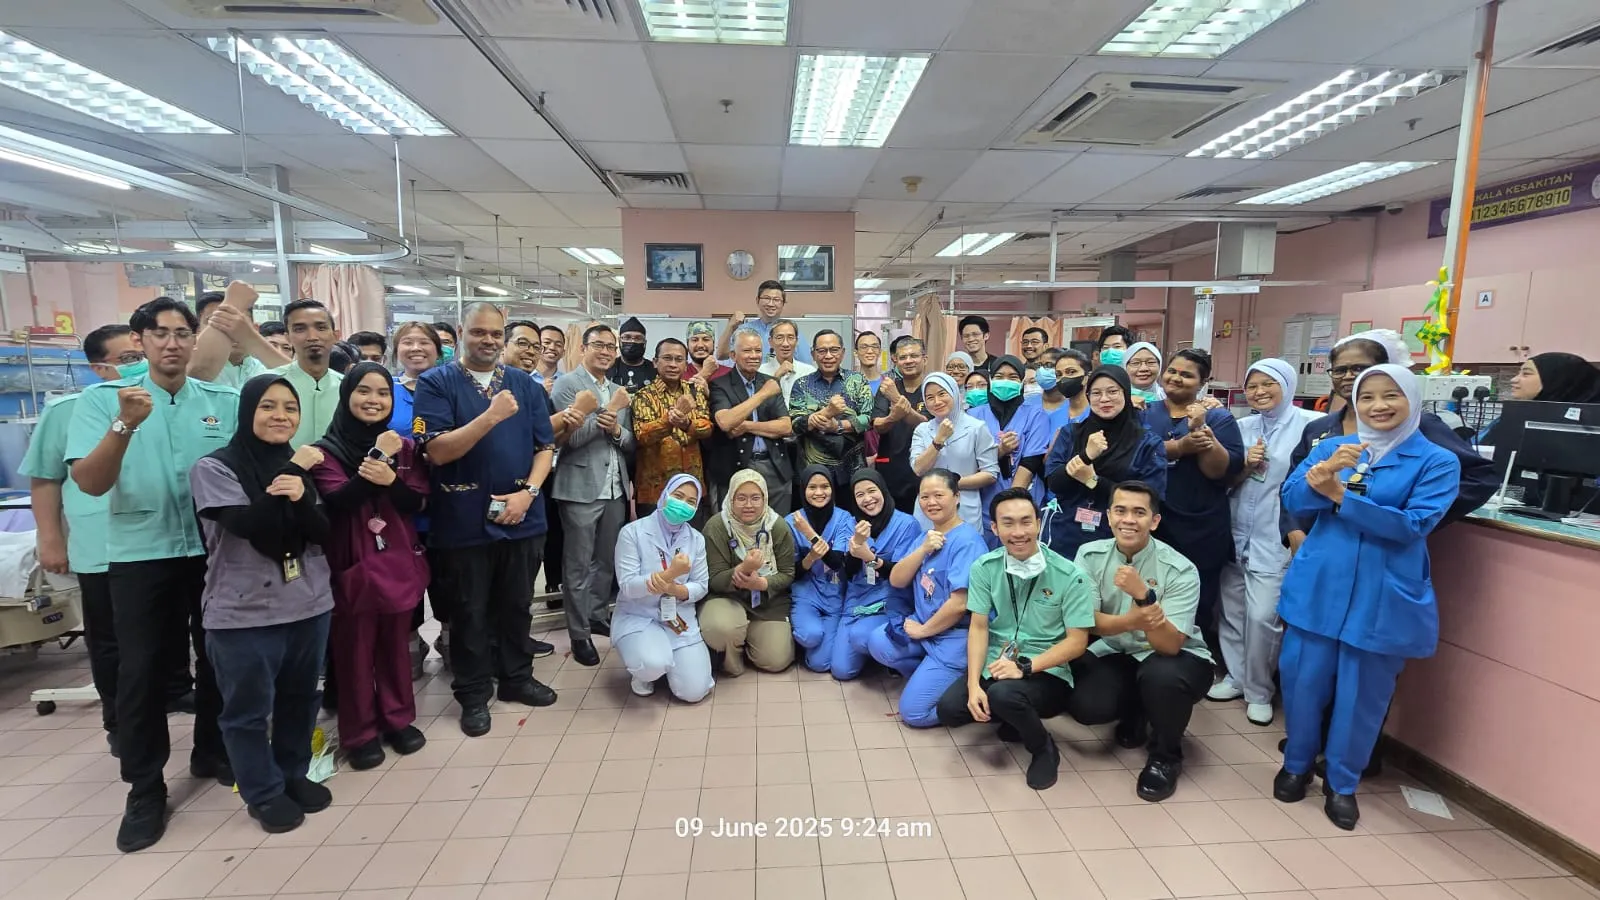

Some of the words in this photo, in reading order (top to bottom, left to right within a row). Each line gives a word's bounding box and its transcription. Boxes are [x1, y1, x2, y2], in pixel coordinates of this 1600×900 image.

[1475, 189, 1502, 202] KALA
[1505, 172, 1573, 195] KESAKITAN
[1481, 294, 1489, 303] A
[55, 314, 74, 334] 3
